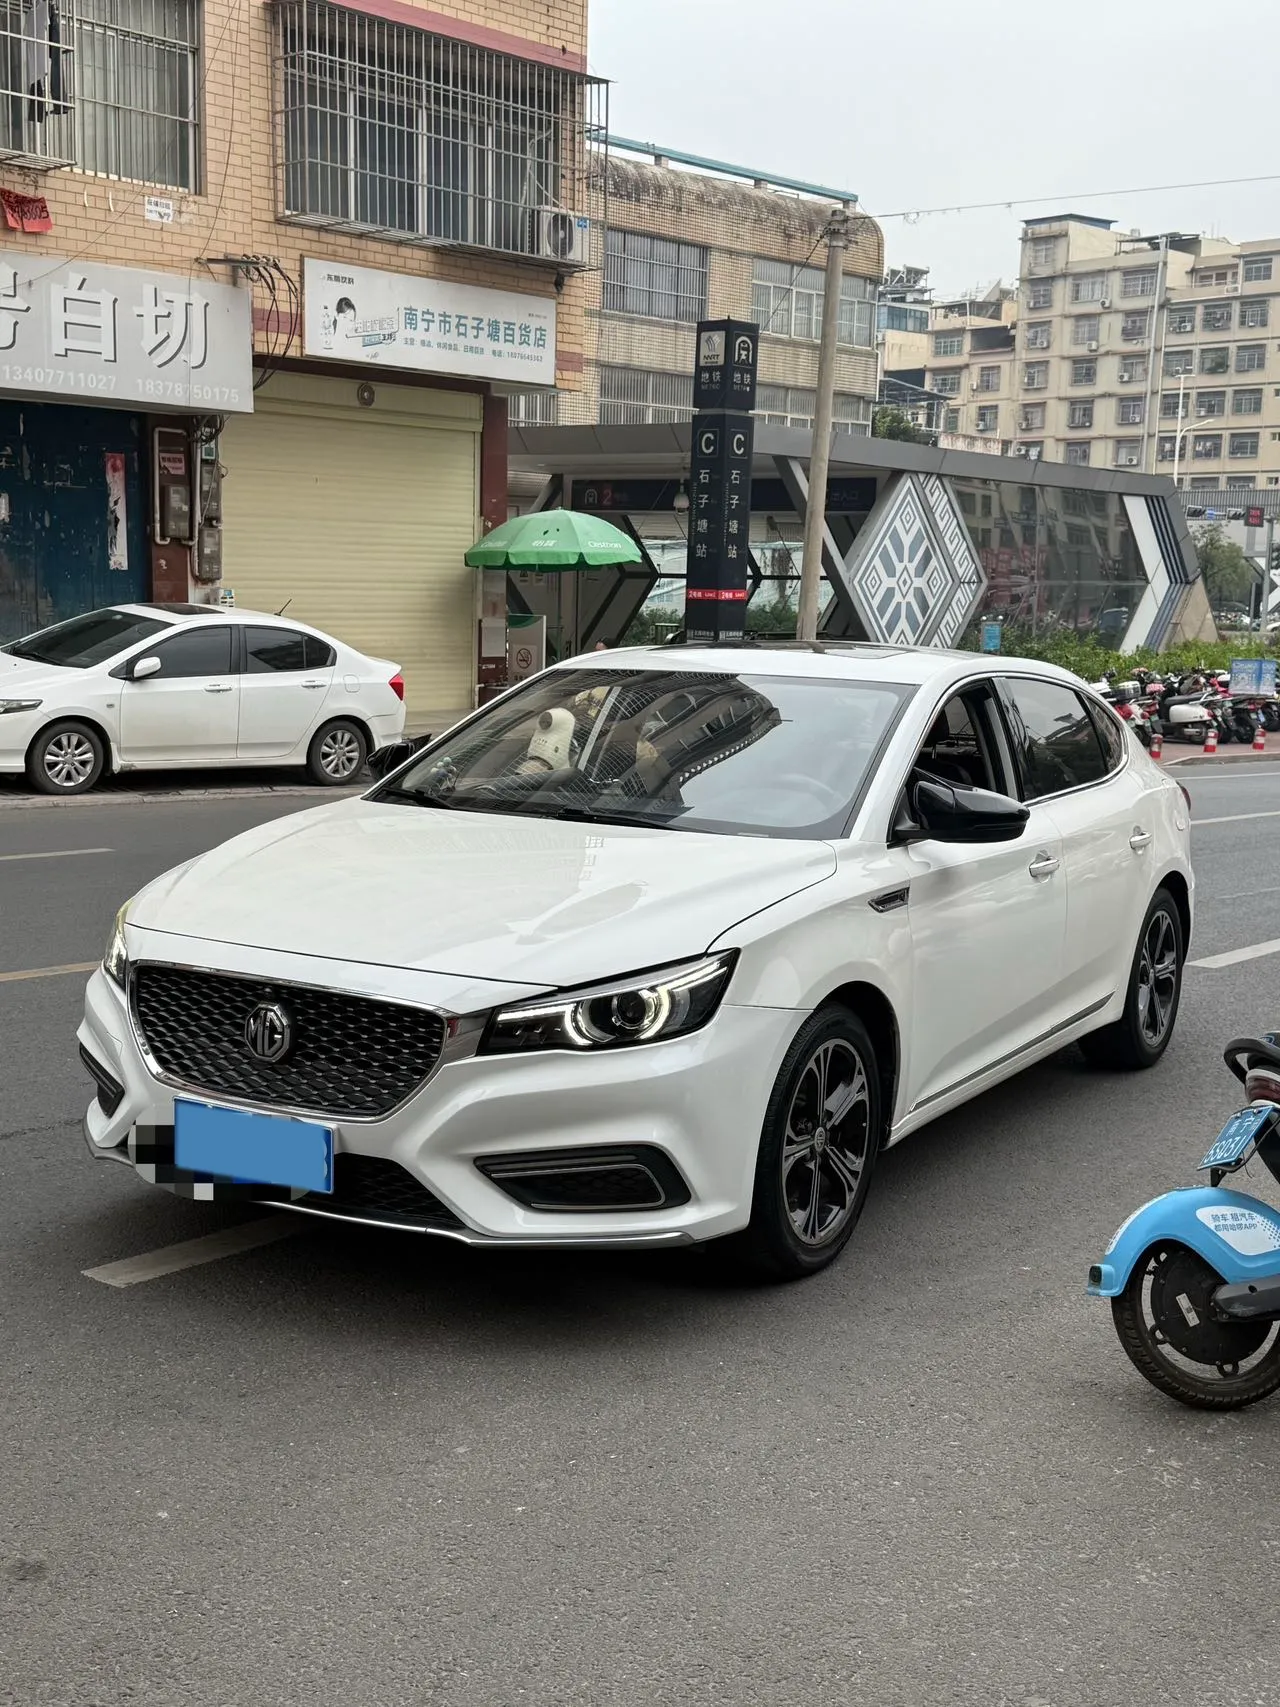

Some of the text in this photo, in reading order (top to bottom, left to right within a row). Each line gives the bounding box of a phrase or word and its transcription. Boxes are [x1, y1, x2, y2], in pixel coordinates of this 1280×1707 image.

[403, 305, 547, 350] 南宁市石子塘百货店
[2, 364, 239, 403] 13407711027 18378750175
[701, 370, 721, 383] 地铁
[733, 371, 751, 384] 地铁
[701, 433, 715, 454] C
[733, 433, 745, 455] C
[696, 469, 710, 558] 石子塘站
[728, 470, 741, 558] 石子塘站
[247, 1009, 283, 1057] MG
